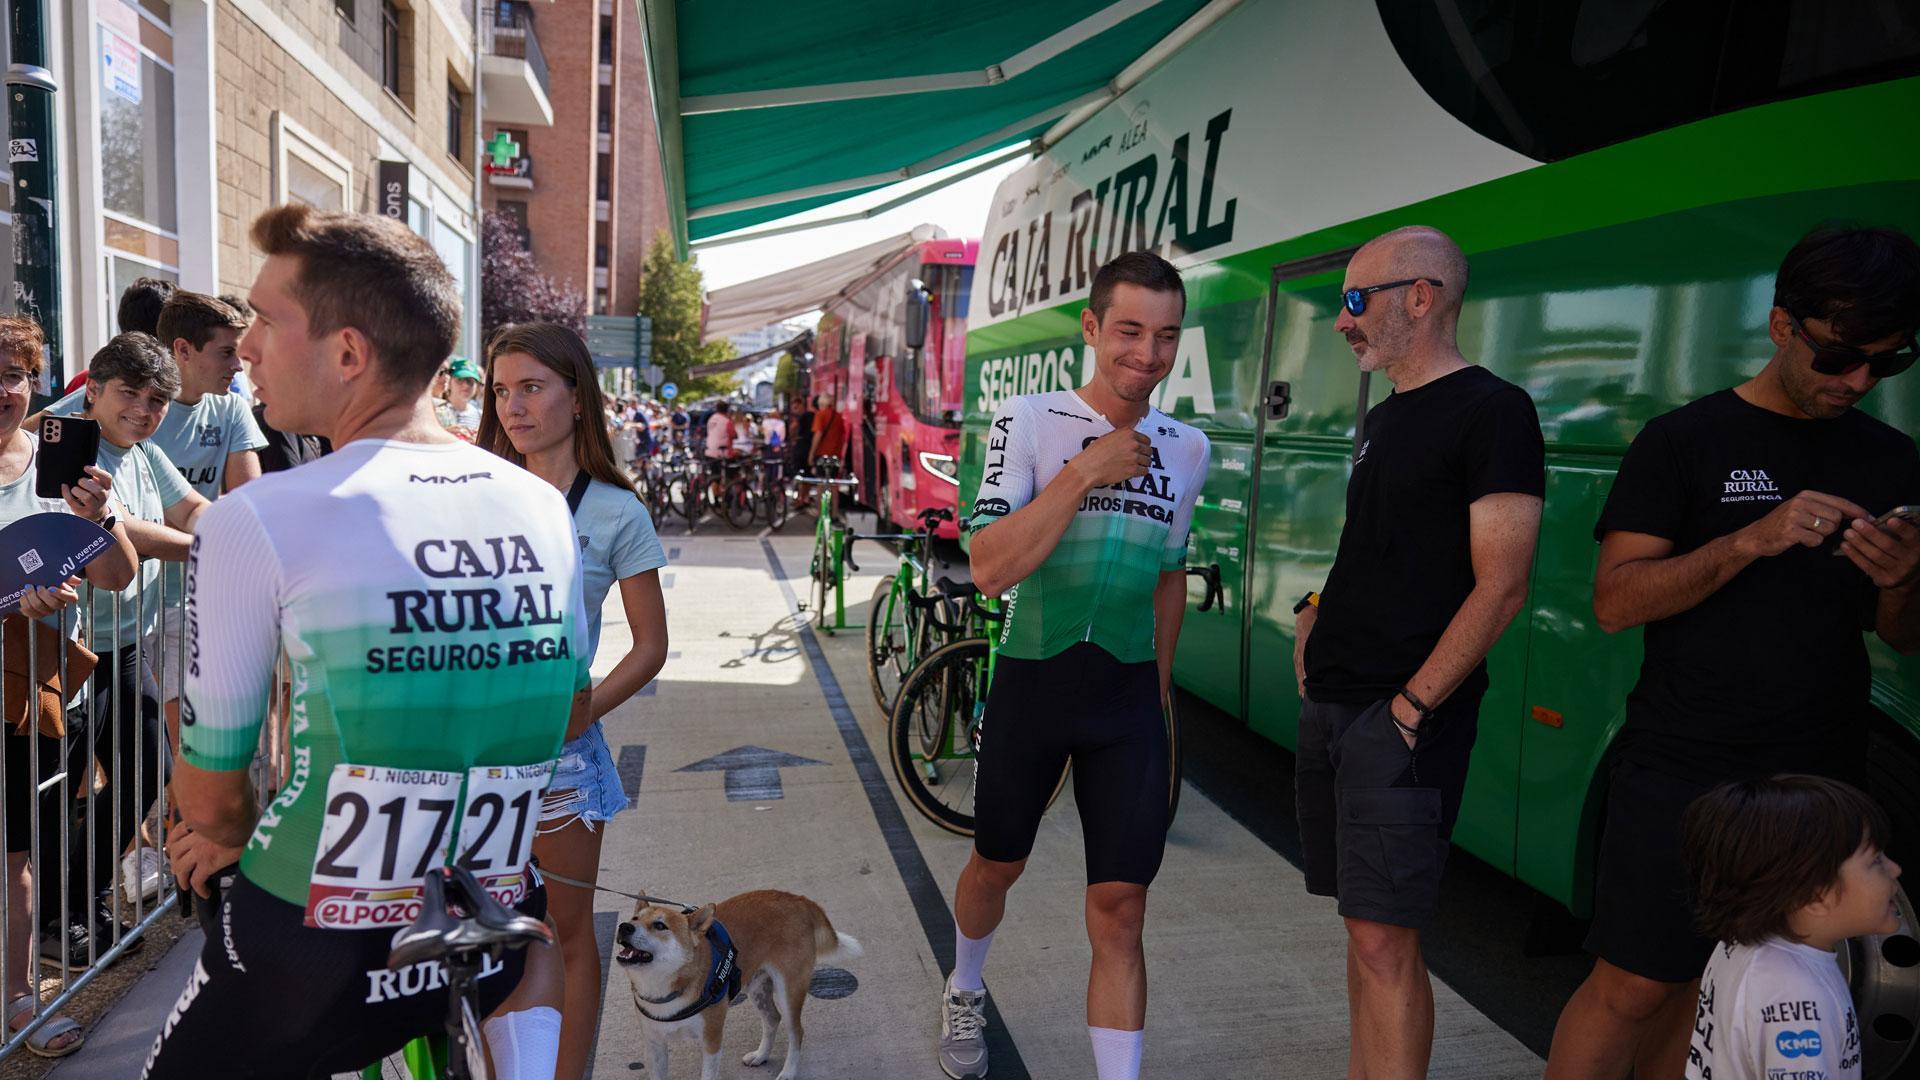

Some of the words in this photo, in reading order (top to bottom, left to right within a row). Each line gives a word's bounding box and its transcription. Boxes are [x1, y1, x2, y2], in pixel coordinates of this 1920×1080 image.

[988, 211, 1052, 318] CAJA
[1059, 107, 1238, 295] RURAL
[978, 347, 1075, 413] SEGUROS
[985, 415, 1013, 487] ALEA
[1723, 480, 1778, 493] RURAL
[1730, 469, 1770, 481] CAJA
[1122, 499, 1174, 526] RGA
[1720, 495, 1755, 503] SEGUROS
[75, 536, 105, 560] wenea
[414, 534, 544, 580] CAJA
[386, 583, 563, 634] RURAL
[366, 642, 501, 674] SEGUROS
[507, 636, 570, 667] RGA
[368, 768, 380, 782] J.
[246, 746, 311, 851] RURAL
[315, 791, 455, 882] 217
[457, 788, 547, 871] 21
[365, 952, 504, 1004] RURL
[1778, 1037, 1821, 1050] KMC
